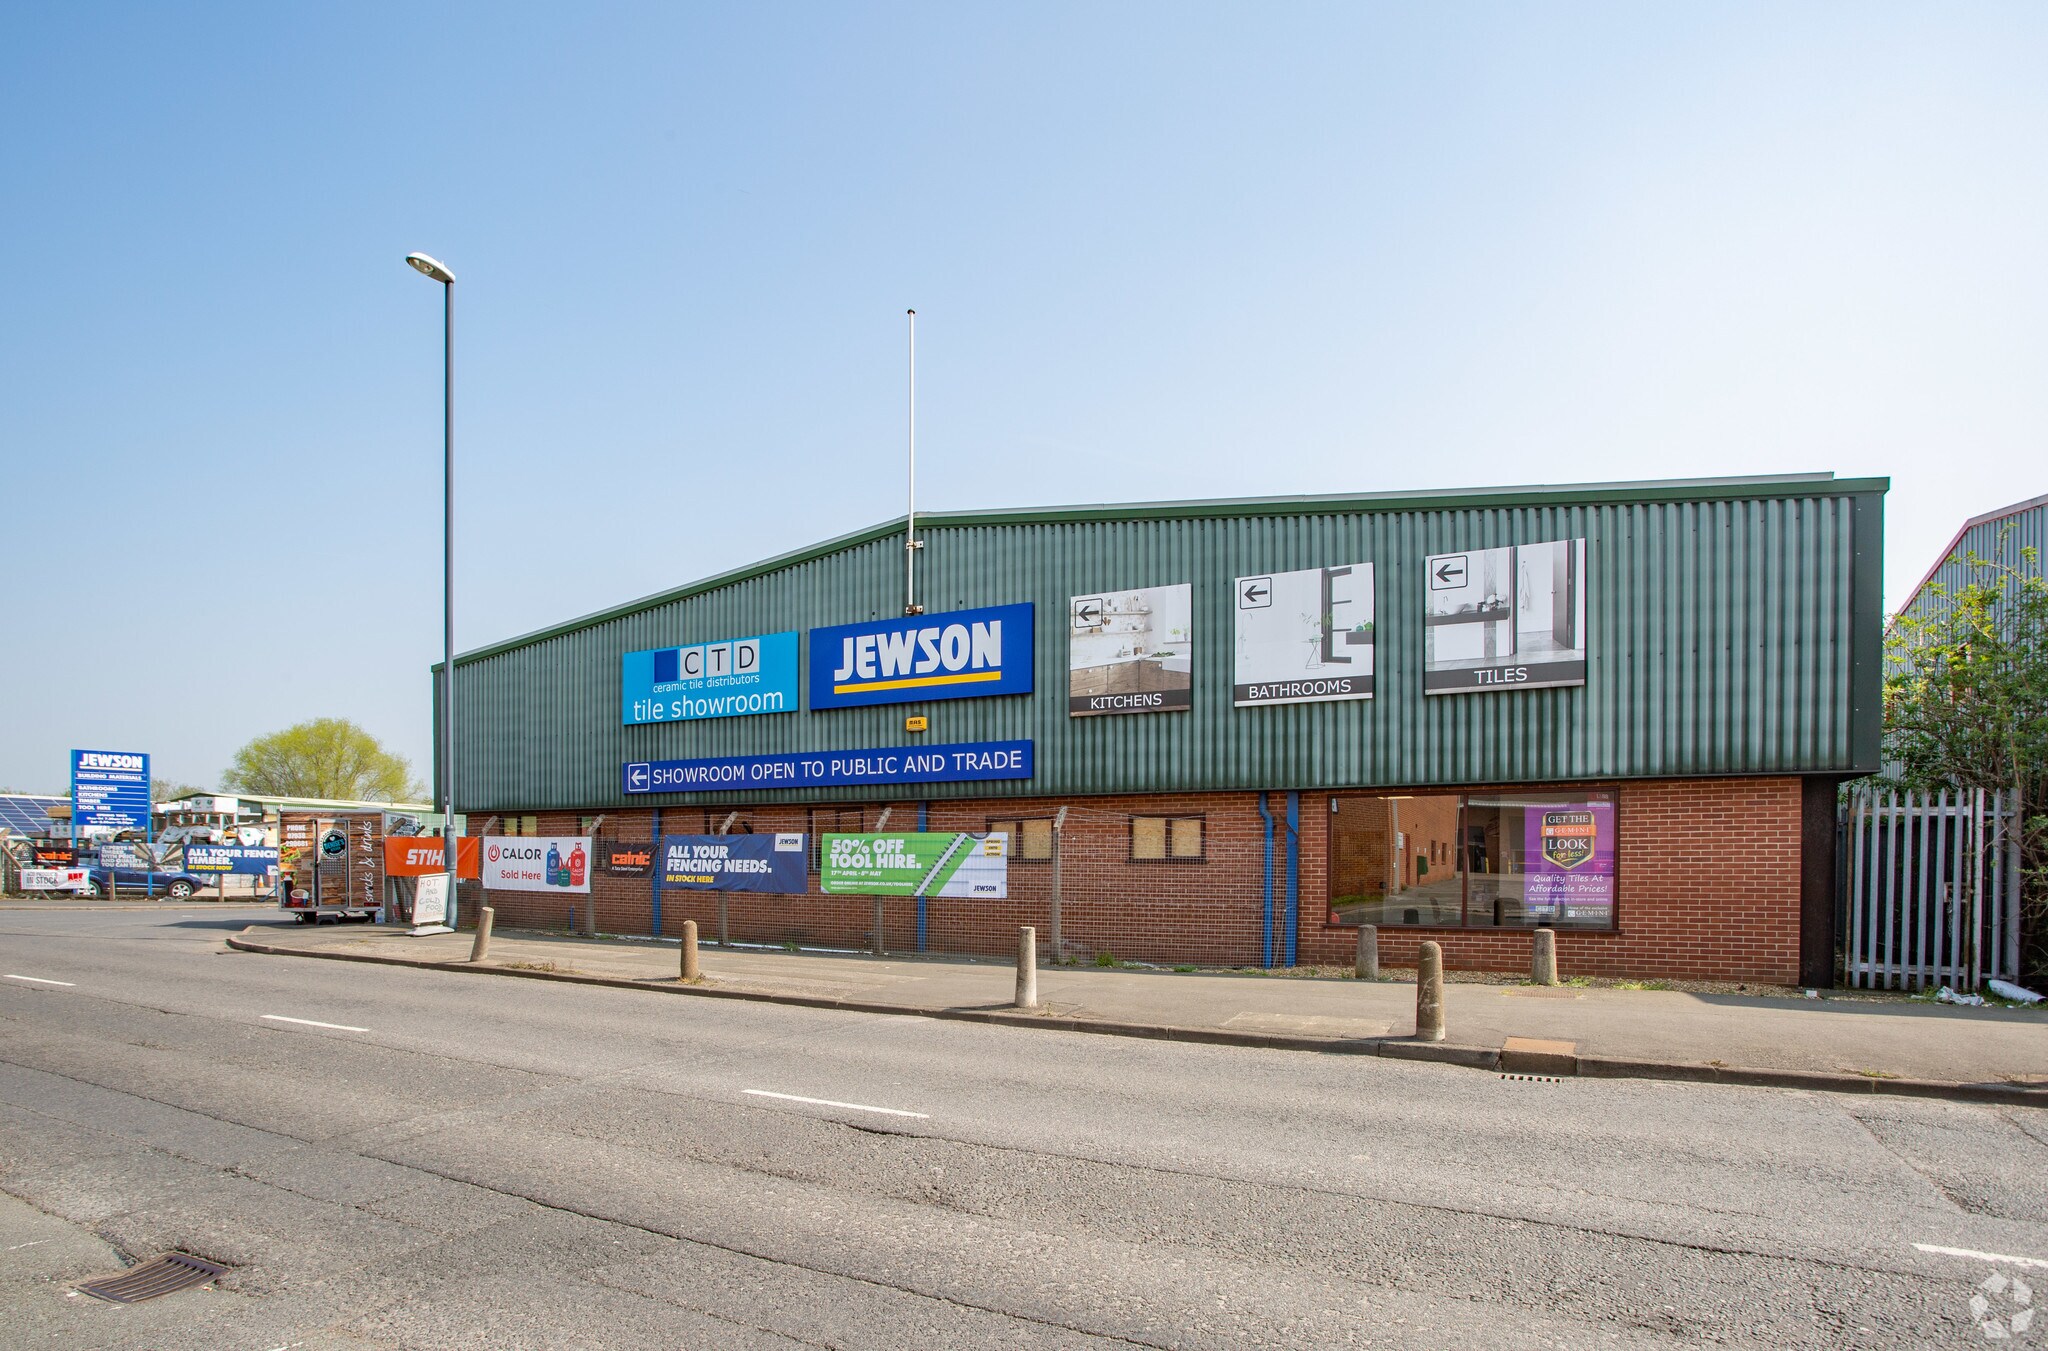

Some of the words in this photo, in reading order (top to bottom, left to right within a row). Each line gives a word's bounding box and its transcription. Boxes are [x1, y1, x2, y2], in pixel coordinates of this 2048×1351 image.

[834, 620, 1001, 681] JEWSON
[685, 645, 754, 675] CTD
[1473, 667, 1528, 684] TILES
[653, 681, 686, 693] ceramic
[689, 679, 703, 689] tile
[706, 674, 760, 688] distributors
[1248, 679, 1352, 699] BATHROOMS
[634, 699, 663, 721] tile
[671, 691, 783, 718] showroom
[1090, 693, 1162, 710] KITCHENS
[79, 753, 143, 768] JEWSON
[653, 765, 745, 784] SHOWROOM
[751, 762, 795, 780] OPEN
[801, 760, 824, 777] TO
[831, 757, 897, 776] PUBLIC
[903, 755, 945, 773] AND
[952, 750, 1022, 771] TRADE
[1548, 815, 1567, 823] GET
[1569, 815, 1589, 823] THE
[358, 820, 373, 852] drinks
[831, 839, 870, 854] 50%
[873, 839, 905, 854] OFF
[1548, 839, 1588, 850] LOOK
[188, 848, 208, 857] ALL
[209, 849, 242, 858] YOUR
[502, 848, 542, 860] CALOR
[611, 851, 650, 865] catnic
[668, 845, 690, 858] ALL
[692, 845, 728, 859] YOUR
[1552, 851, 1567, 859] for
[1568, 849, 1584, 858] less!
[188, 857, 233, 865] TIMBER.
[359, 855, 375, 868] &
[666, 858, 722, 873] FENCING
[724, 859, 772, 874] NEEDS.
[830, 853, 873, 868] TOOL
[876, 854, 922, 869] HIRE.
[500, 869, 519, 879] Sold
[521, 870, 541, 880] Here
[666, 874, 675, 882] IN
[675, 874, 696, 883] STOCK
[696, 875, 715, 883] HERE
[1533, 874, 1565, 884] Quality
[1569, 874, 1589, 882] Tiles
[1591, 874, 1604, 882] At
[420, 878, 439, 888] HOT
[1529, 884, 1575, 893] Affordable
[1578, 884, 1608, 892] Prices!
[418, 897, 441, 905] COLD
[425, 903, 443, 912] FOOD
